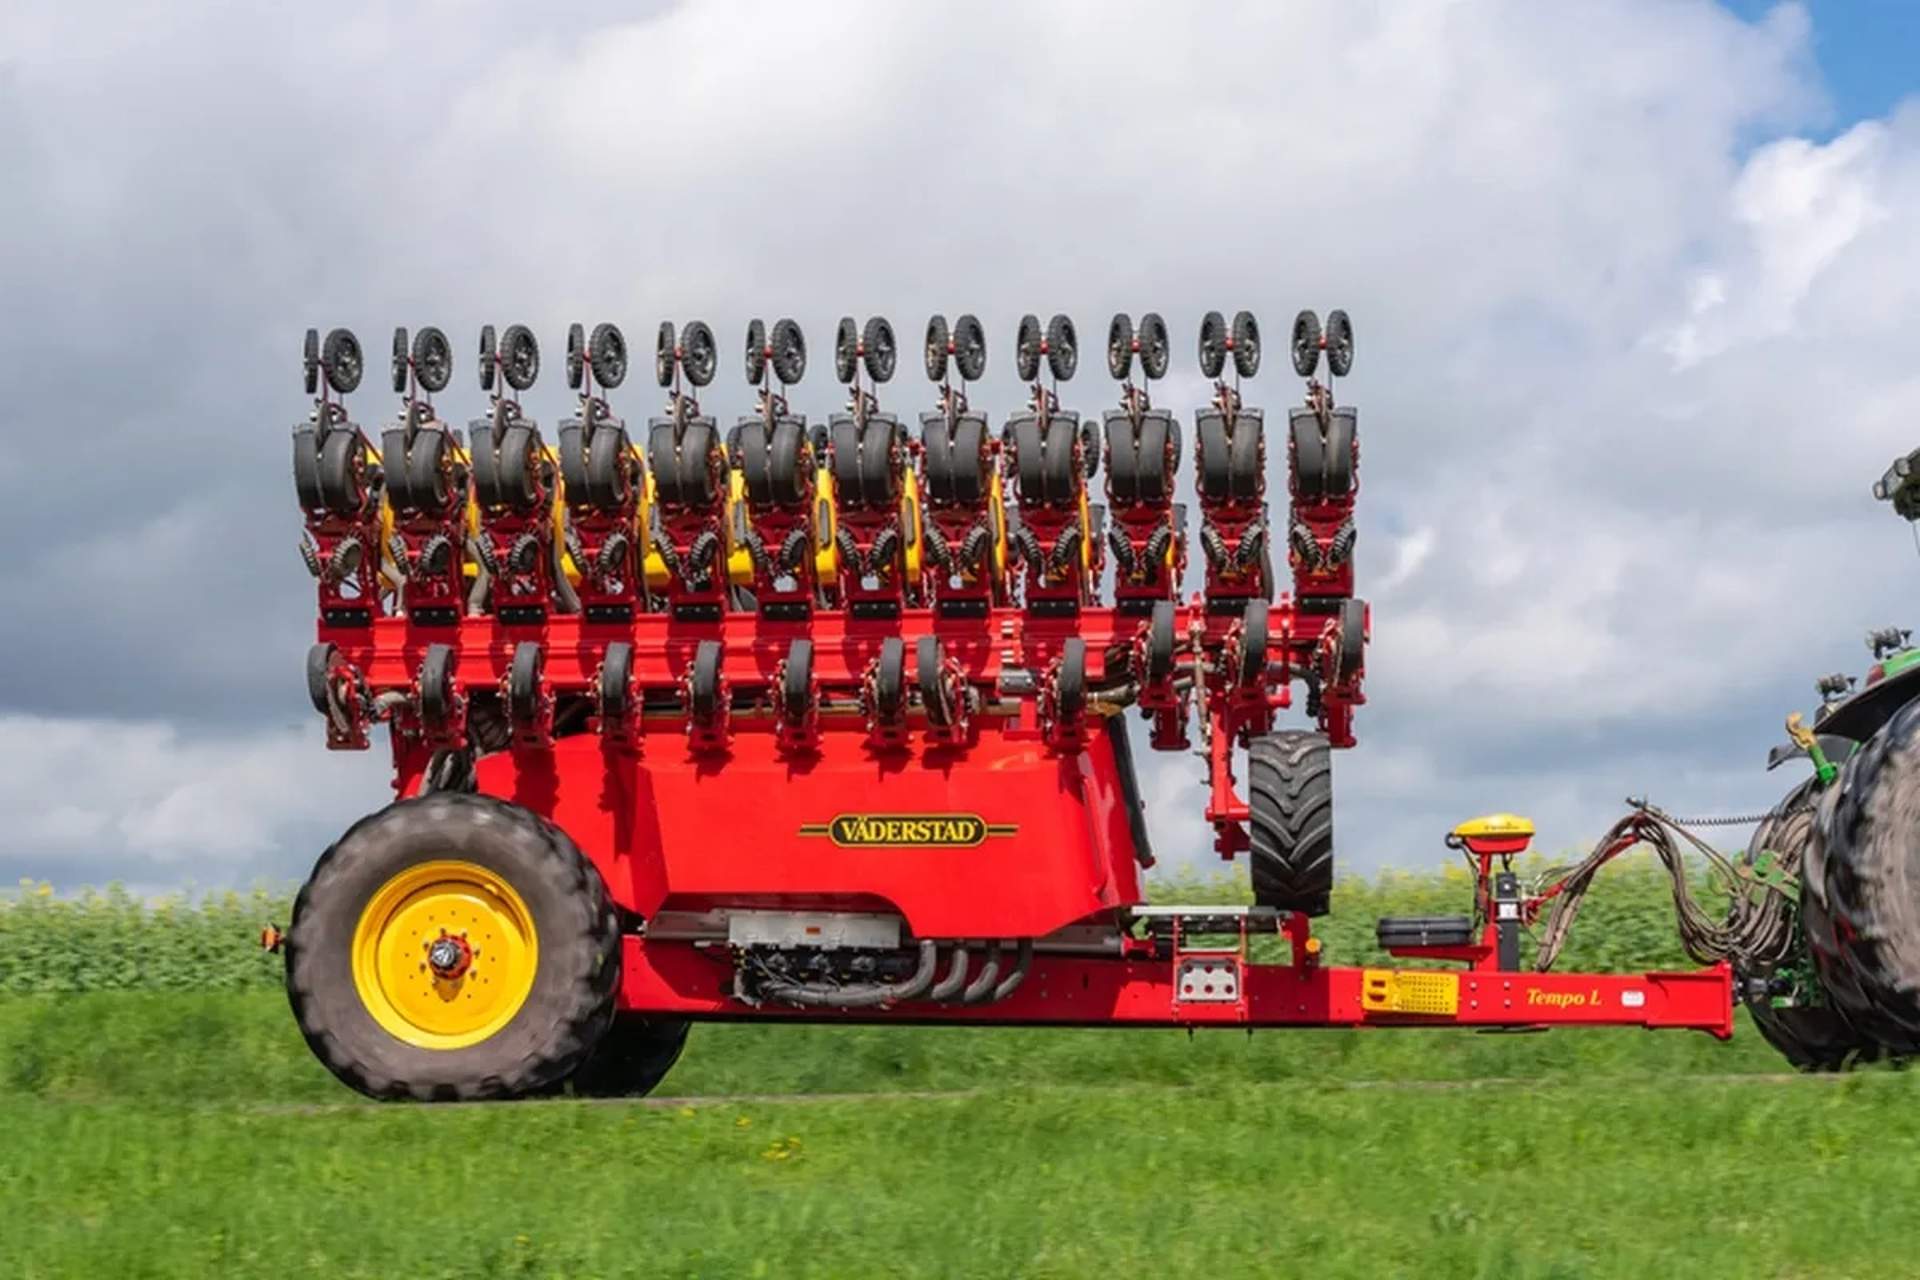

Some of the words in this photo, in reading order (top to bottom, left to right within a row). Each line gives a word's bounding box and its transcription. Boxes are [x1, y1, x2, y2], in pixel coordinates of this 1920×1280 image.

[840, 816, 975, 842] VÄDERSTAD
[1527, 988, 1585, 1008] Tempo
[1590, 989, 1601, 1006] L
